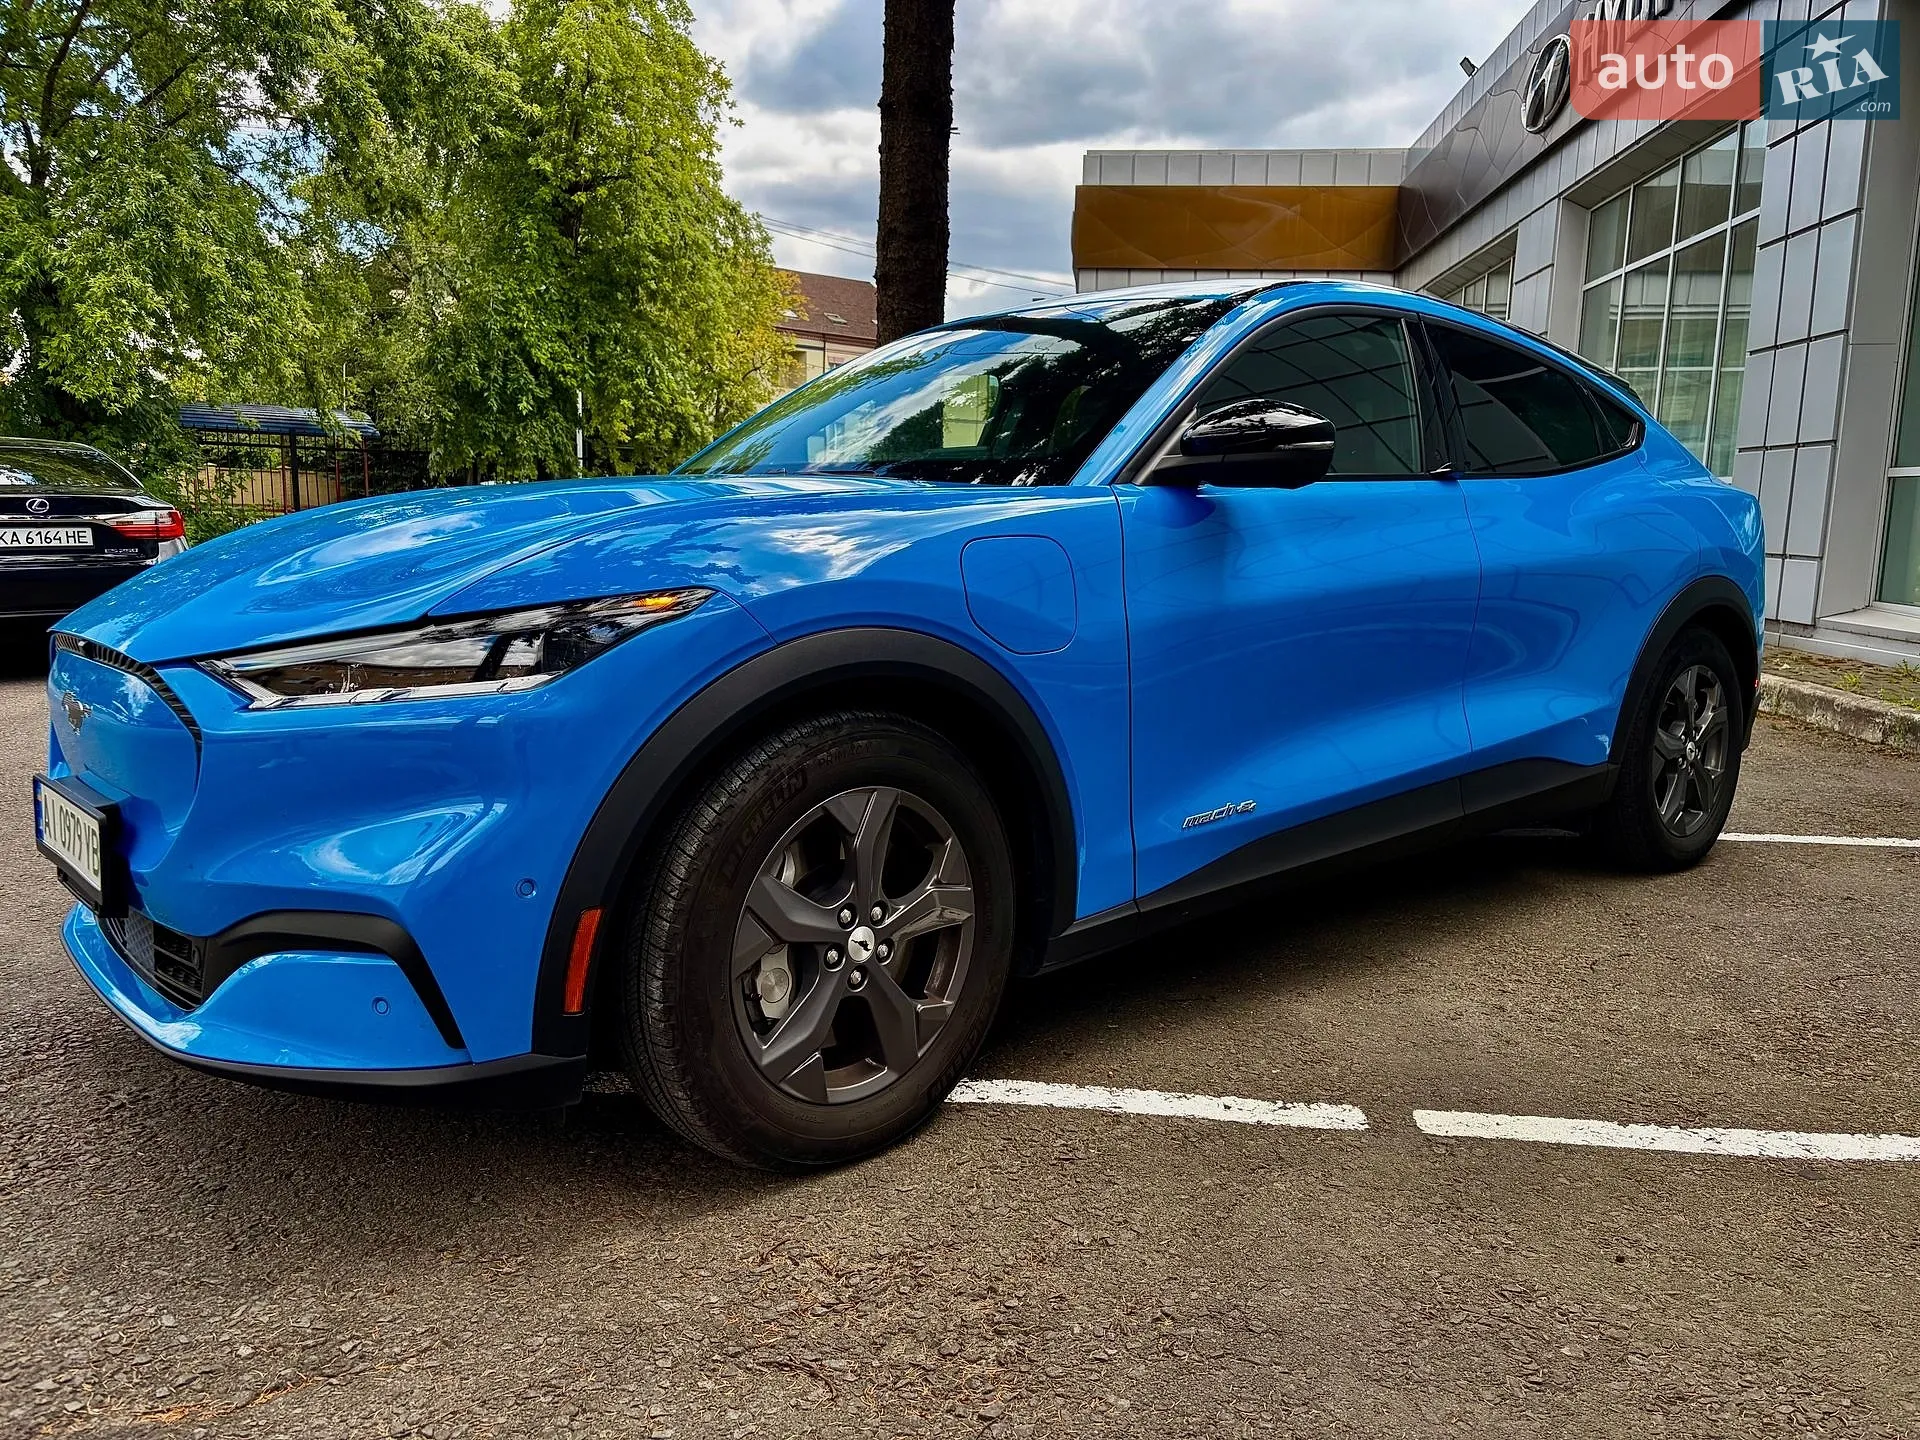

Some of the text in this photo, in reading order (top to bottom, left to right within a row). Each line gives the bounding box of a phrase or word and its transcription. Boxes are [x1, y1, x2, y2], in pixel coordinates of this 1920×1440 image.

[25, 531, 61, 544] 6164
[66, 530, 88, 544] HE
[44, 793, 100, 877] AI 0979 YB
